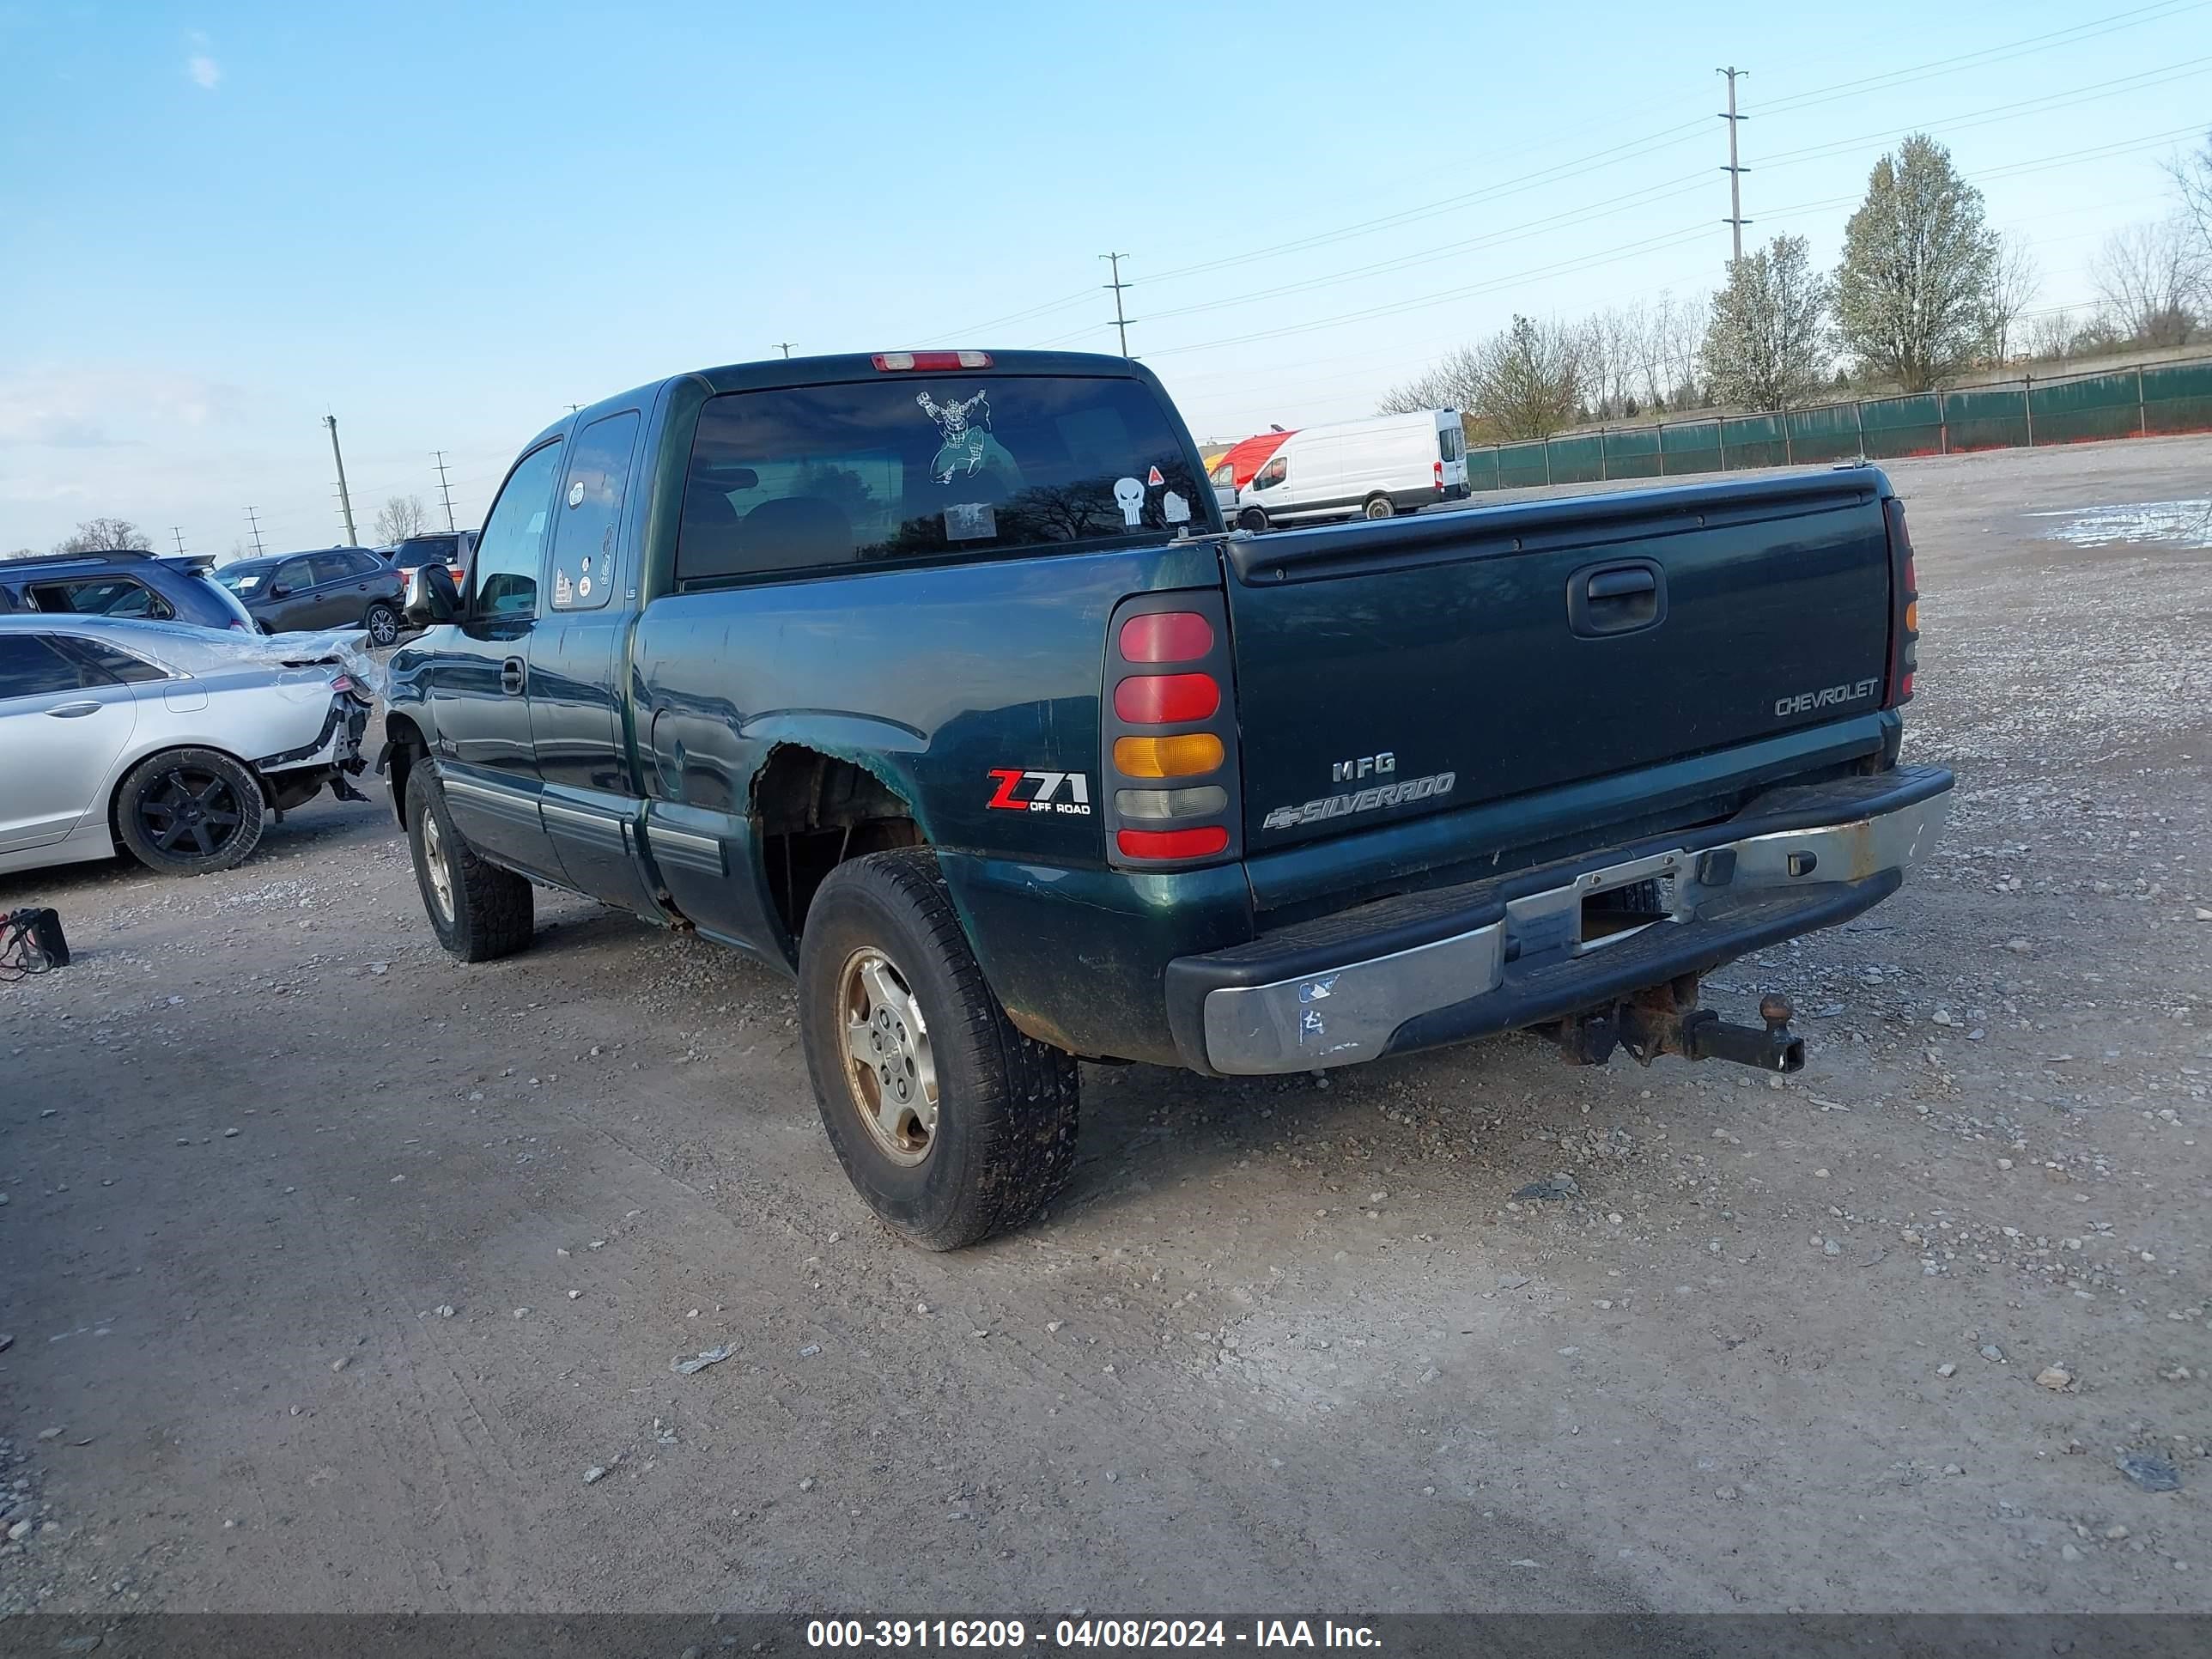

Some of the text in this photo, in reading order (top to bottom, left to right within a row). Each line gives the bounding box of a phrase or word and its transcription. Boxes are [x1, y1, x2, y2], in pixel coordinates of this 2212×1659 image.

[1774, 677, 1879, 717] CHEVROLET
[1332, 751, 1396, 782] MFG
[988, 769, 1090, 810] Z71
[1030, 801, 1091, 815] OFF ROAD
[1299, 771, 1456, 825] SILVERADO
